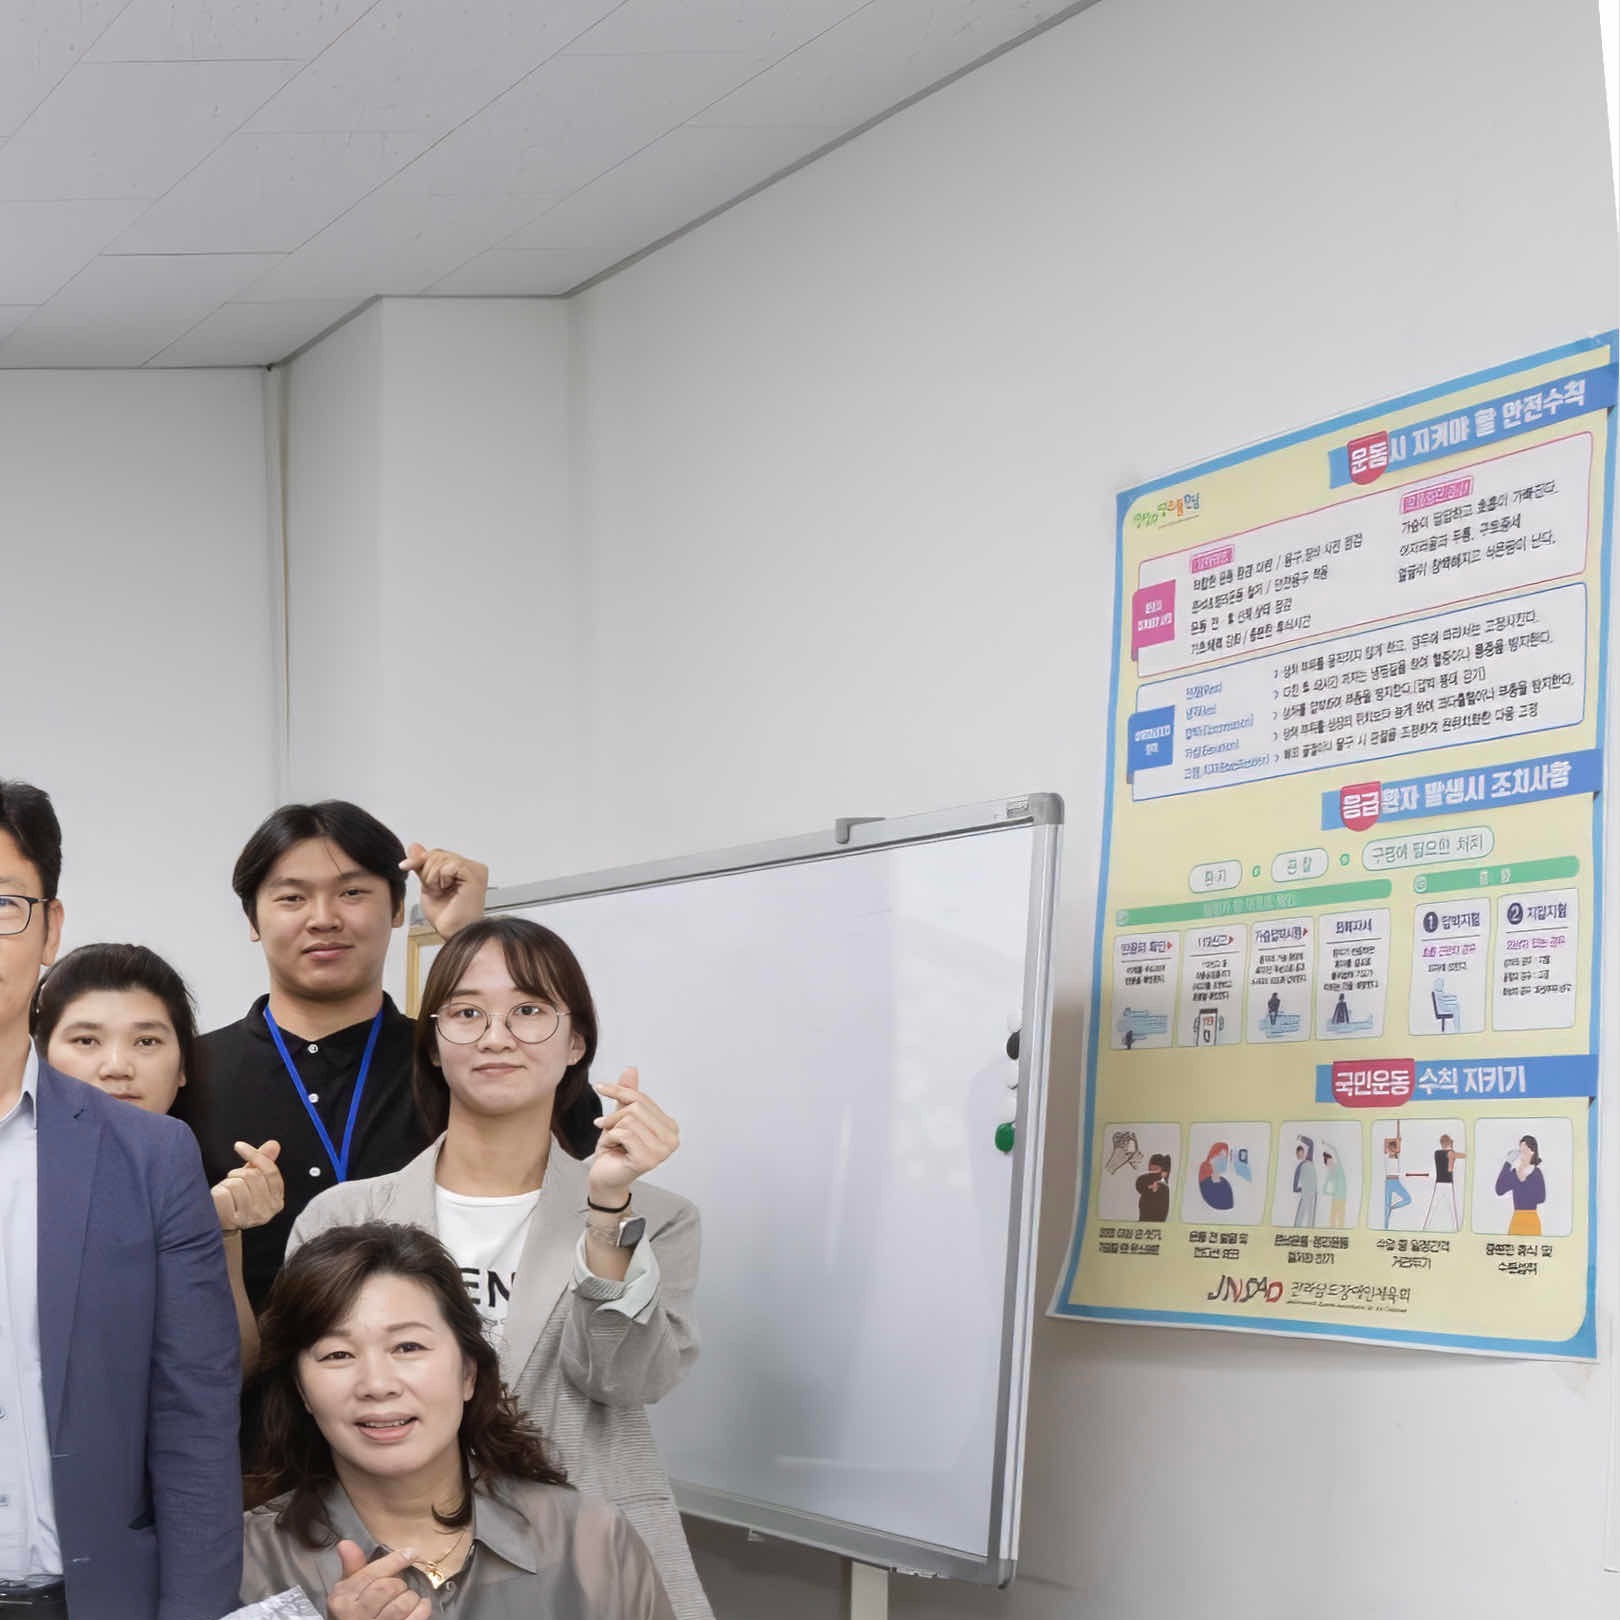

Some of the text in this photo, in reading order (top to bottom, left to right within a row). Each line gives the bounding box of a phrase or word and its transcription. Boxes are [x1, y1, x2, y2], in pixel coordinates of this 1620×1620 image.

[1335, 1065, 1527, 1096] 국민운동 수칙 지키기
